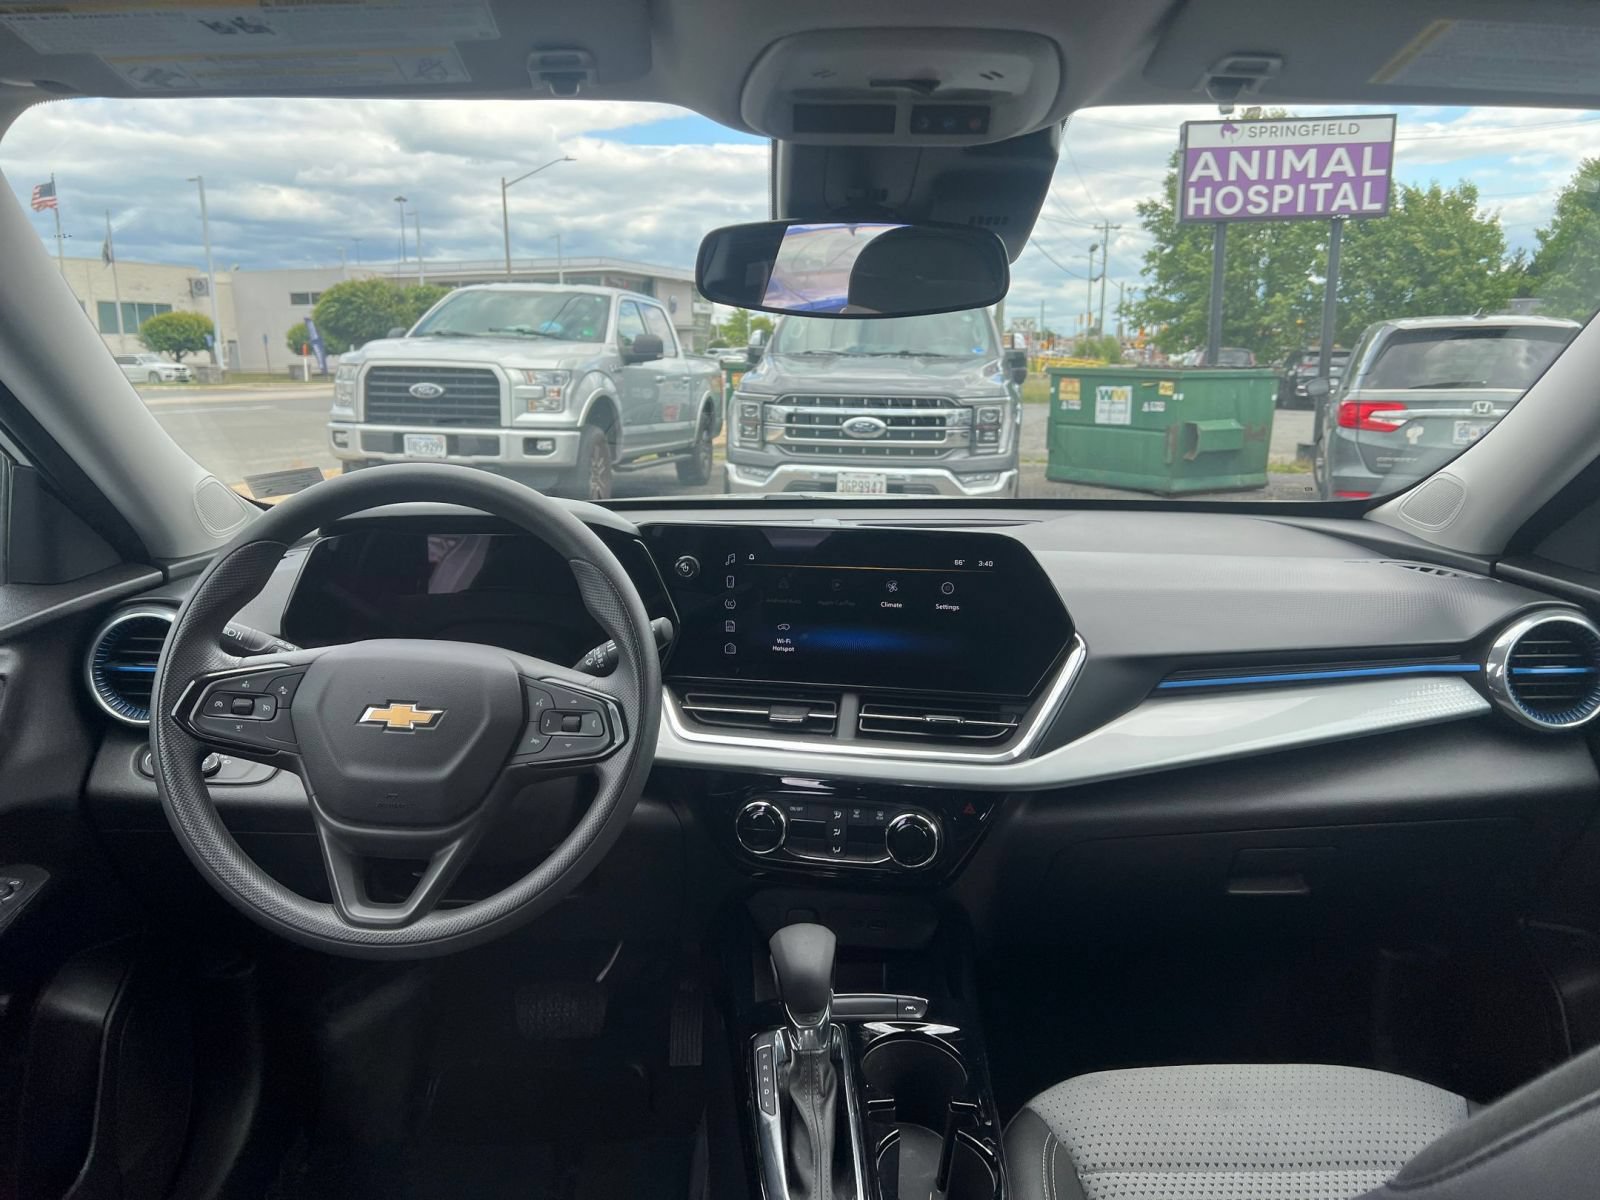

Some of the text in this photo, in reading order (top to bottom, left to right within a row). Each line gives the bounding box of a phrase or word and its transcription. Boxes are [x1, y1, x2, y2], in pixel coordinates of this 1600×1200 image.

[1247, 122, 1361, 138] SPRINGFIELD
[1188, 146, 1387, 182] ANIMAL
[1186, 181, 1383, 216] HOSPITAL
[880, 601, 903, 609] Climate
[935, 603, 960, 612] Settings
[776, 637, 792, 645] Wi-Fi
[772, 645, 795, 653] Hotspot
